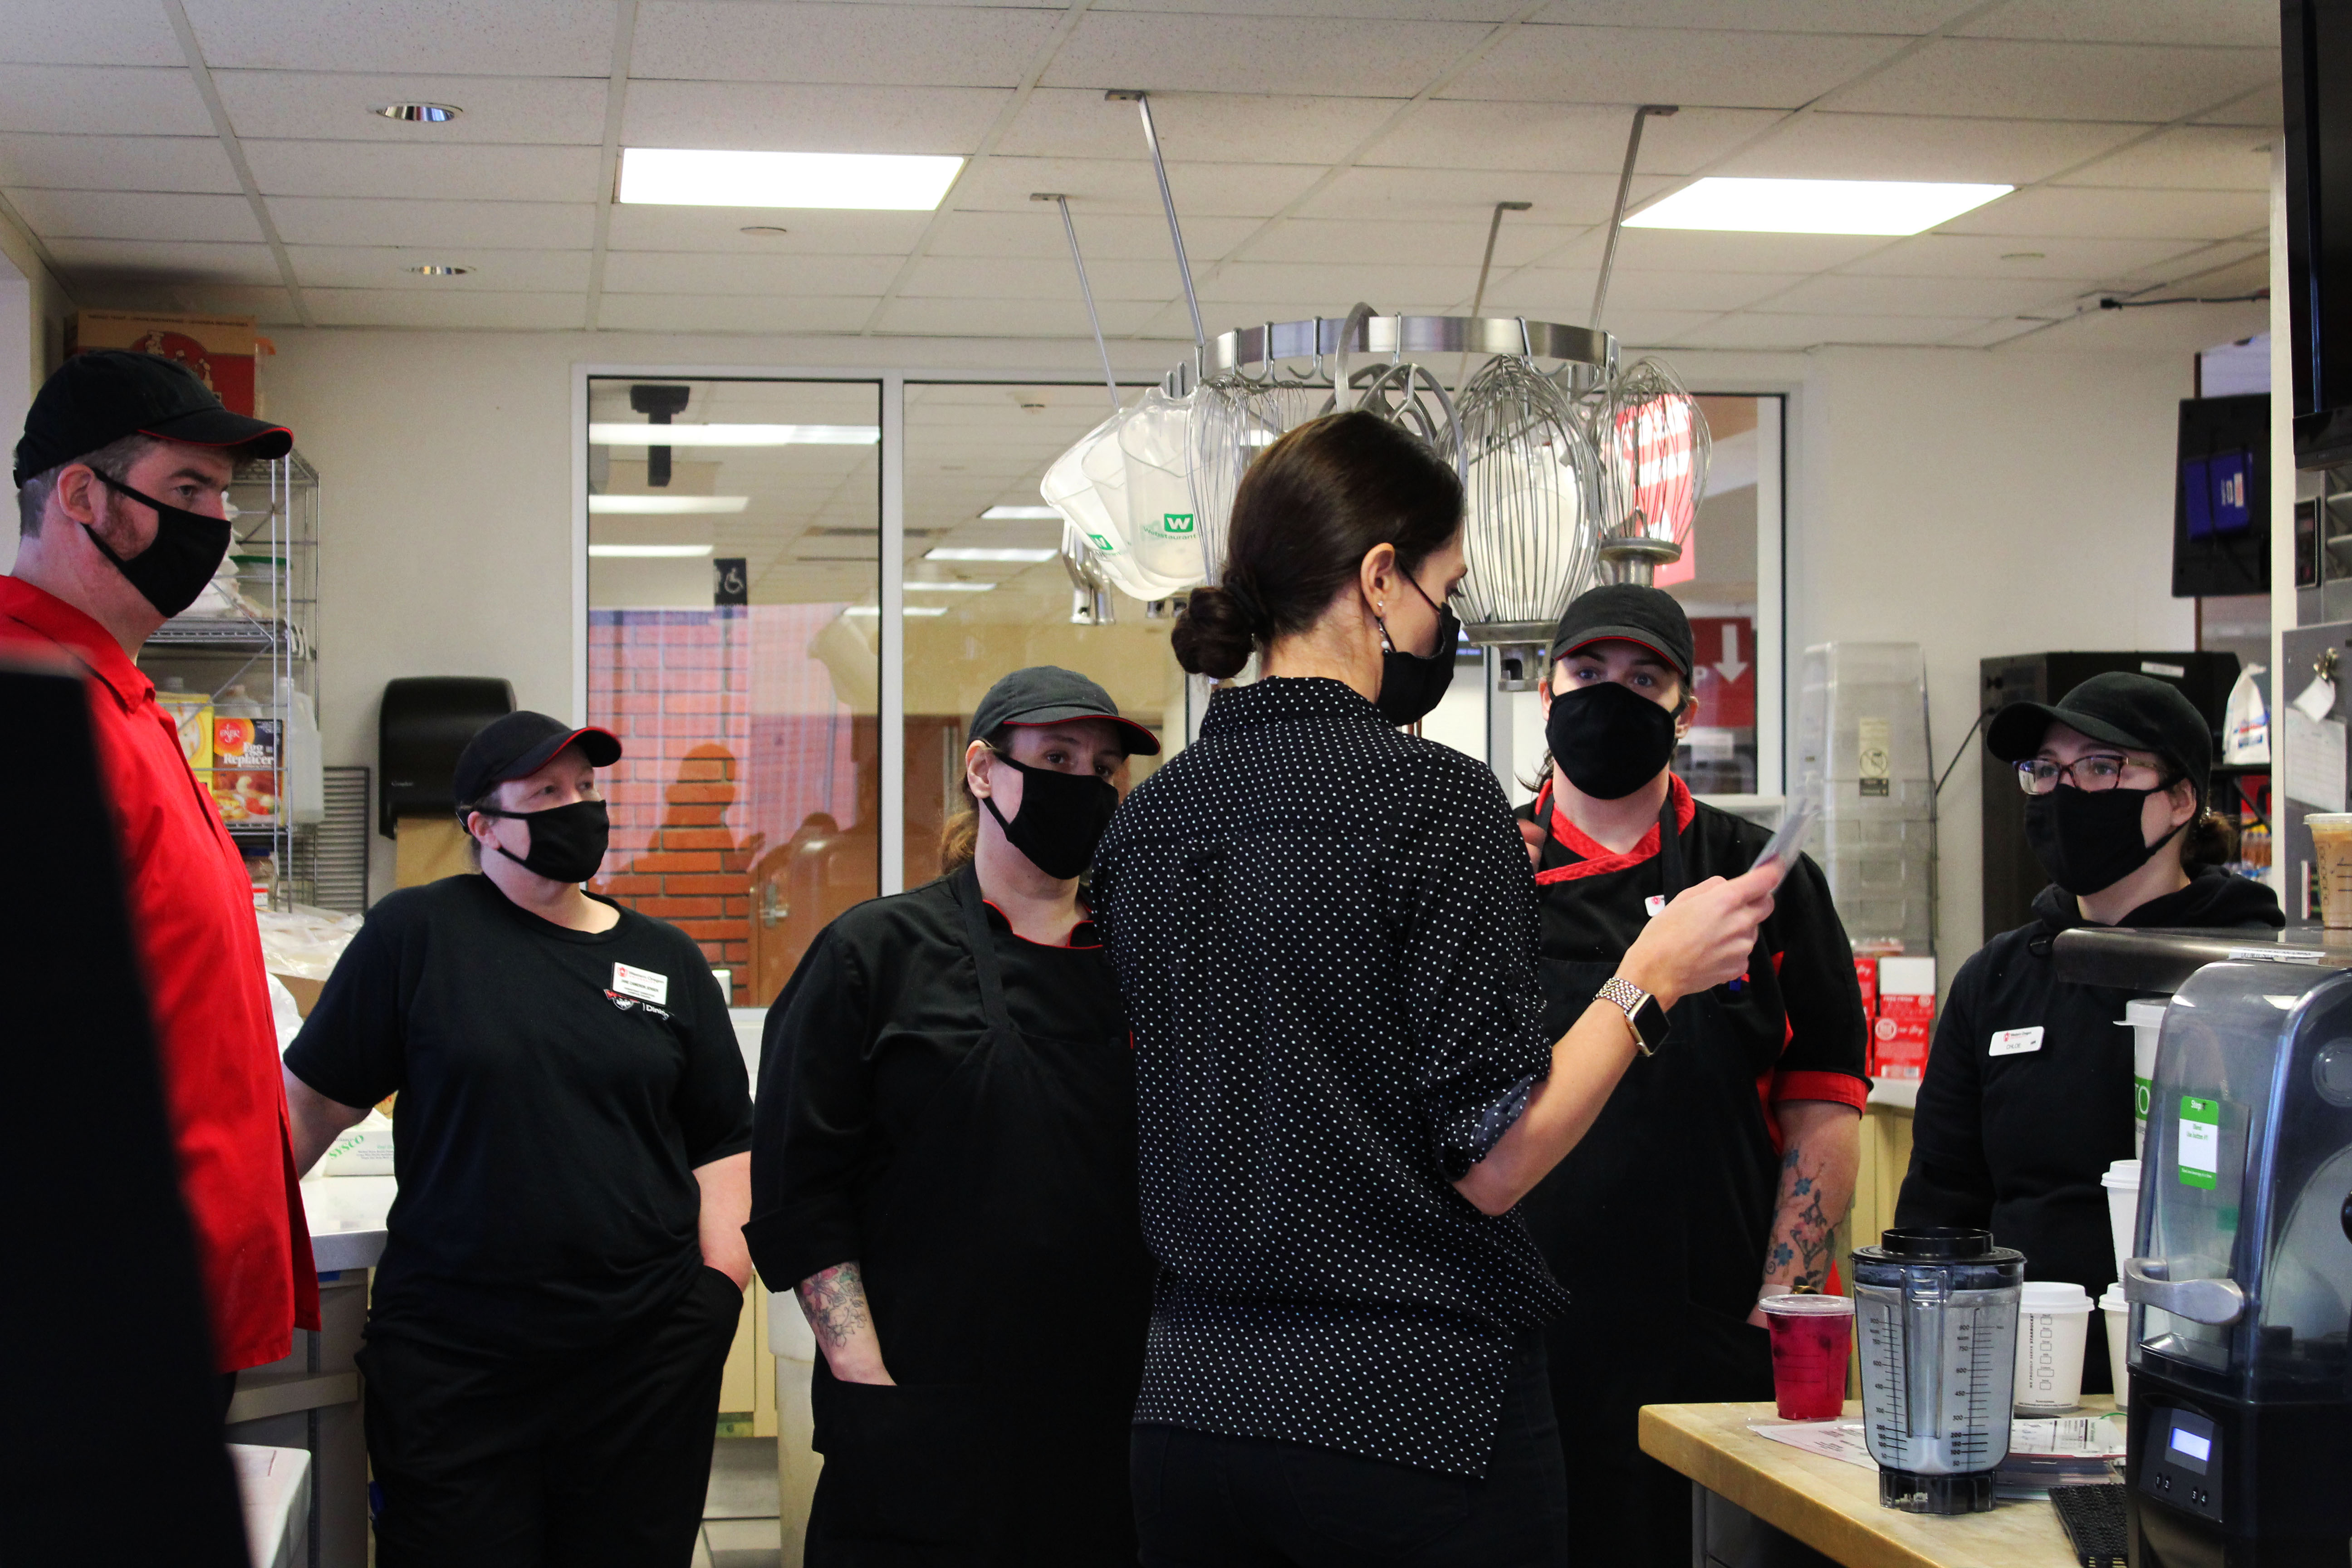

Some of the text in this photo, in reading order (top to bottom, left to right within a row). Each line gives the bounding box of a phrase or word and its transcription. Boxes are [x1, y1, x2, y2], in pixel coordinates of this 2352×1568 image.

[243, 741, 264, 757] Egg
[223, 753, 274, 768] Replacer
[646, 1004, 670, 1021] Dining
[328, 1135, 364, 1160] SYSCO
[2165, 1480, 2169, 1489] 2
[2192, 1490, 2197, 1499] 3
